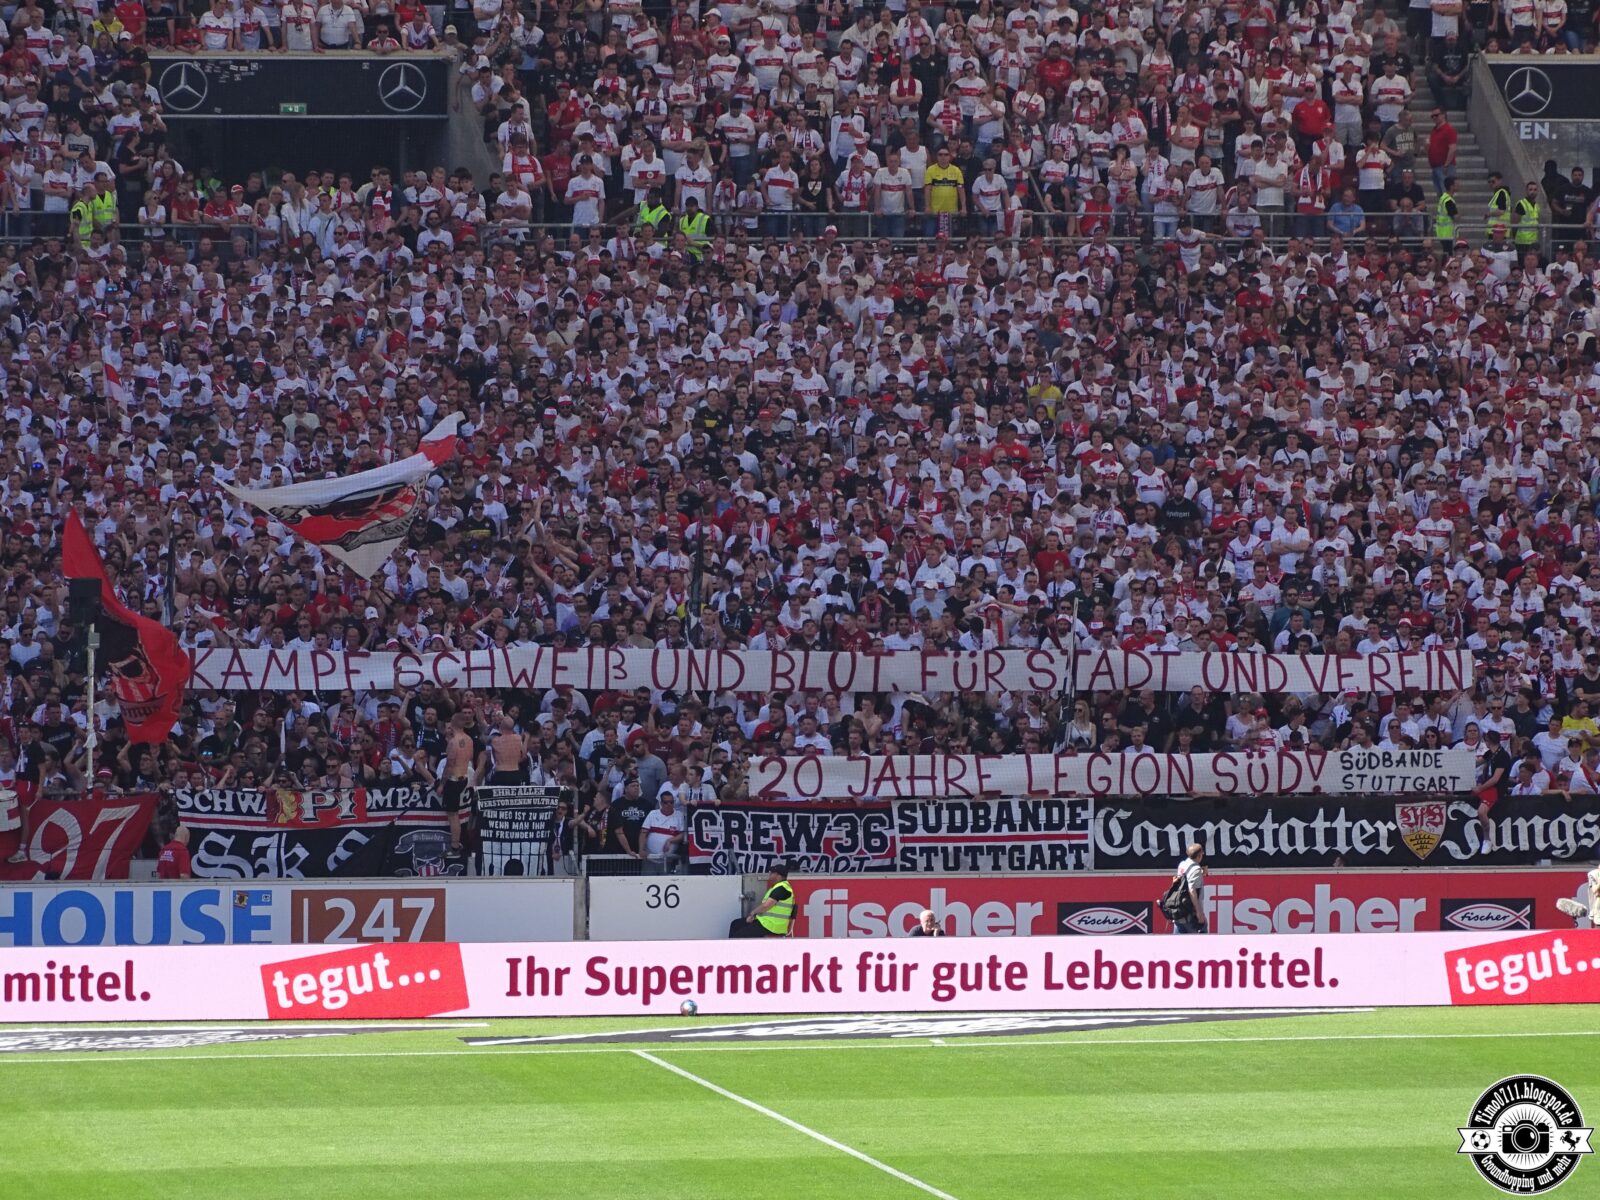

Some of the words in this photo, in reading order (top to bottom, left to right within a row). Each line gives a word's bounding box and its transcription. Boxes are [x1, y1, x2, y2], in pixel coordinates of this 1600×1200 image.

[1513, 121, 1557, 140] EN.
[651, 647, 745, 692] UND
[920, 649, 1008, 692] FÜR
[1026, 649, 1181, 692] STADT
[1201, 652, 1288, 694] UND
[1301, 649, 1465, 693] VEREIN
[758, 755, 824, 798] 20
[847, 753, 1003, 797] JAHRE
[1026, 751, 1195, 797] LEGION
[1340, 752, 1444, 769] SÜDBANDE
[492, 788, 516, 797] EHRE
[1342, 773, 1461, 793] STUTTGART
[480, 829, 493, 838] MIT
[495, 830, 534, 839] FREUNDEN
[691, 809, 828, 853] CREW
[832, 812, 891, 855] 36
[897, 800, 1088, 834] SÜDBANDE
[1094, 807, 1397, 857] Cannstatter
[900, 844, 1088, 871] STUTTGART
[645, 884, 680, 909] 36
[804, 888, 1043, 936] fischer
[1203, 884, 1427, 934] fischer
[323, 897, 435, 943] 247
[1077, 914, 1128, 926] fischer
[1460, 911, 1511, 923] fischer
[4, 960, 151, 1002] mittel.
[272, 951, 441, 1010] tegut...
[505, 956, 571, 997] Ihr
[584, 952, 843, 1006] Supermarkt
[857, 952, 918, 993] für
[930, 955, 1029, 1002] gute
[1044, 947, 1339, 991] Lebensmittel.
